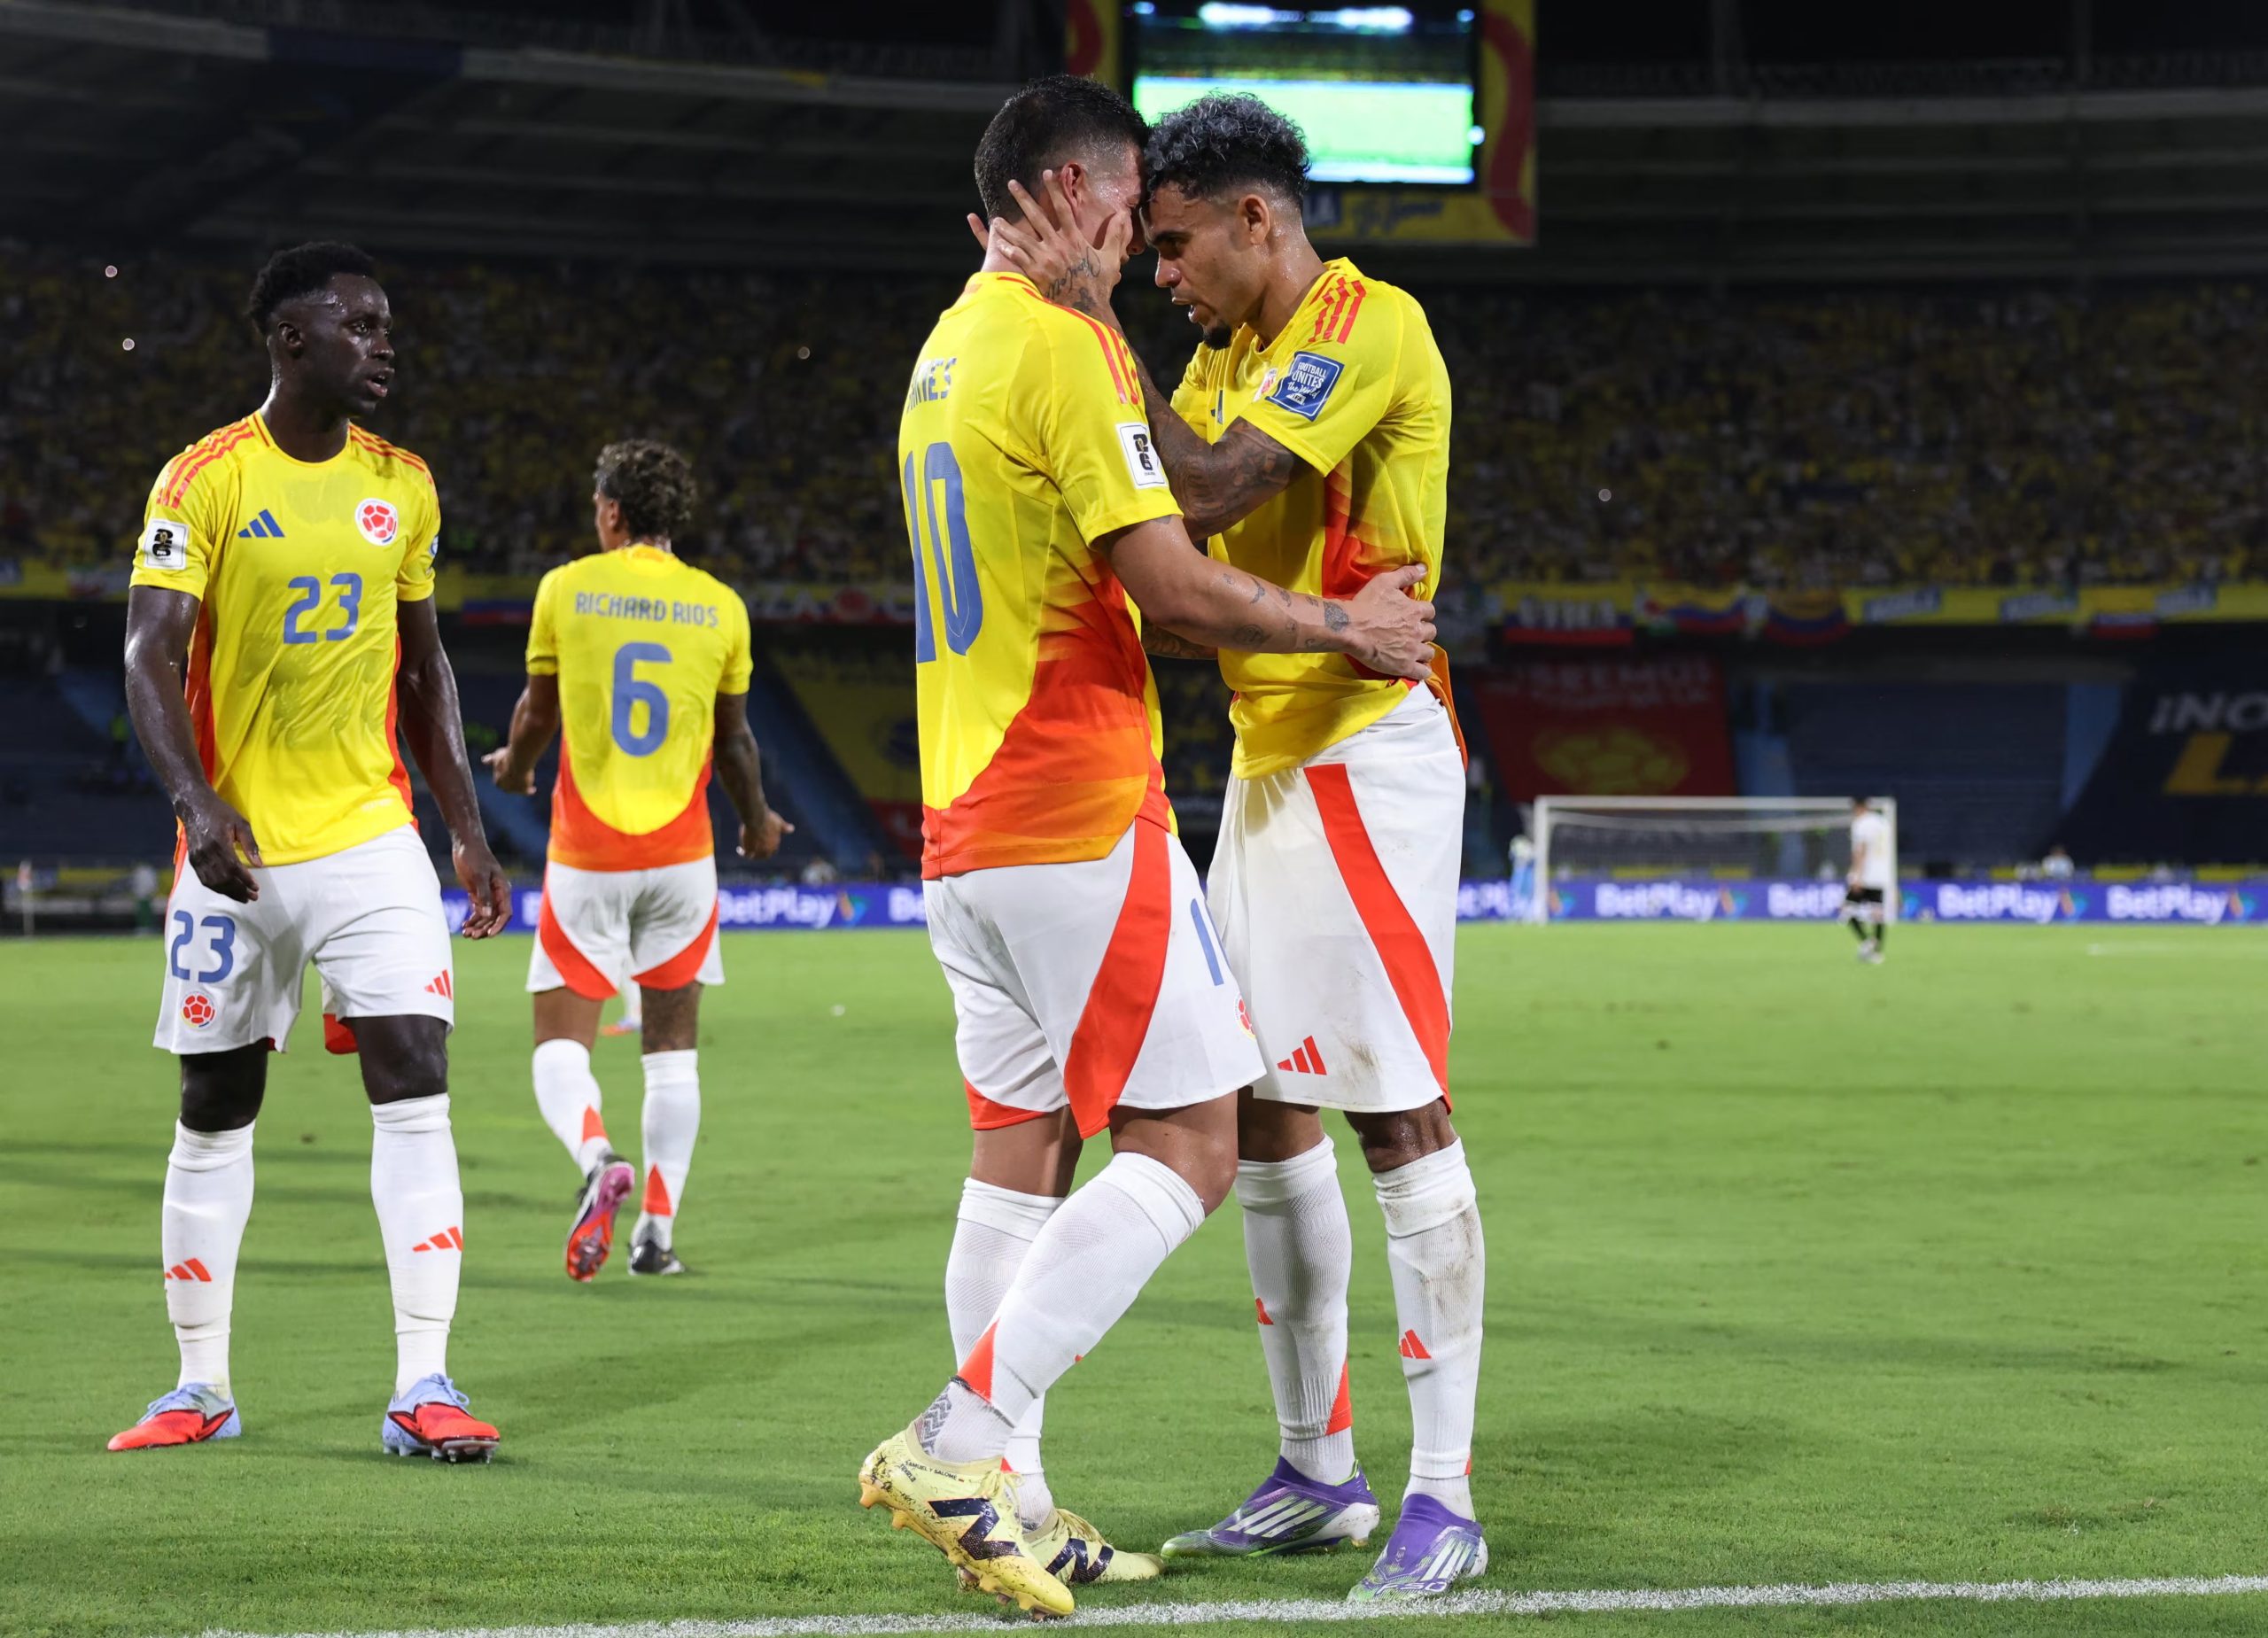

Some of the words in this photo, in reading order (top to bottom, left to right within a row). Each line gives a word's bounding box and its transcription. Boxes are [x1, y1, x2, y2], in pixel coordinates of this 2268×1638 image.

[1287, 381, 1300, 392] the
[1292, 370, 1324, 390] UNITES
[1297, 361, 1327, 379] FOOTBALL
[904, 441, 983, 664] 10
[283, 572, 362, 644] 23
[575, 592, 667, 622] RICHARD
[673, 602, 718, 628] RIOS
[612, 641, 673, 758] 6
[718, 887, 836, 928] BetPlay
[1596, 881, 1719, 922] BetPlay
[1768, 883, 1845, 917] BetP
[1937, 882, 2059, 923] BetPlay
[2106, 883, 2228, 925] BetPlay
[171, 910, 236, 983] 23
[905, 1459, 927, 1471] SAMUEL
